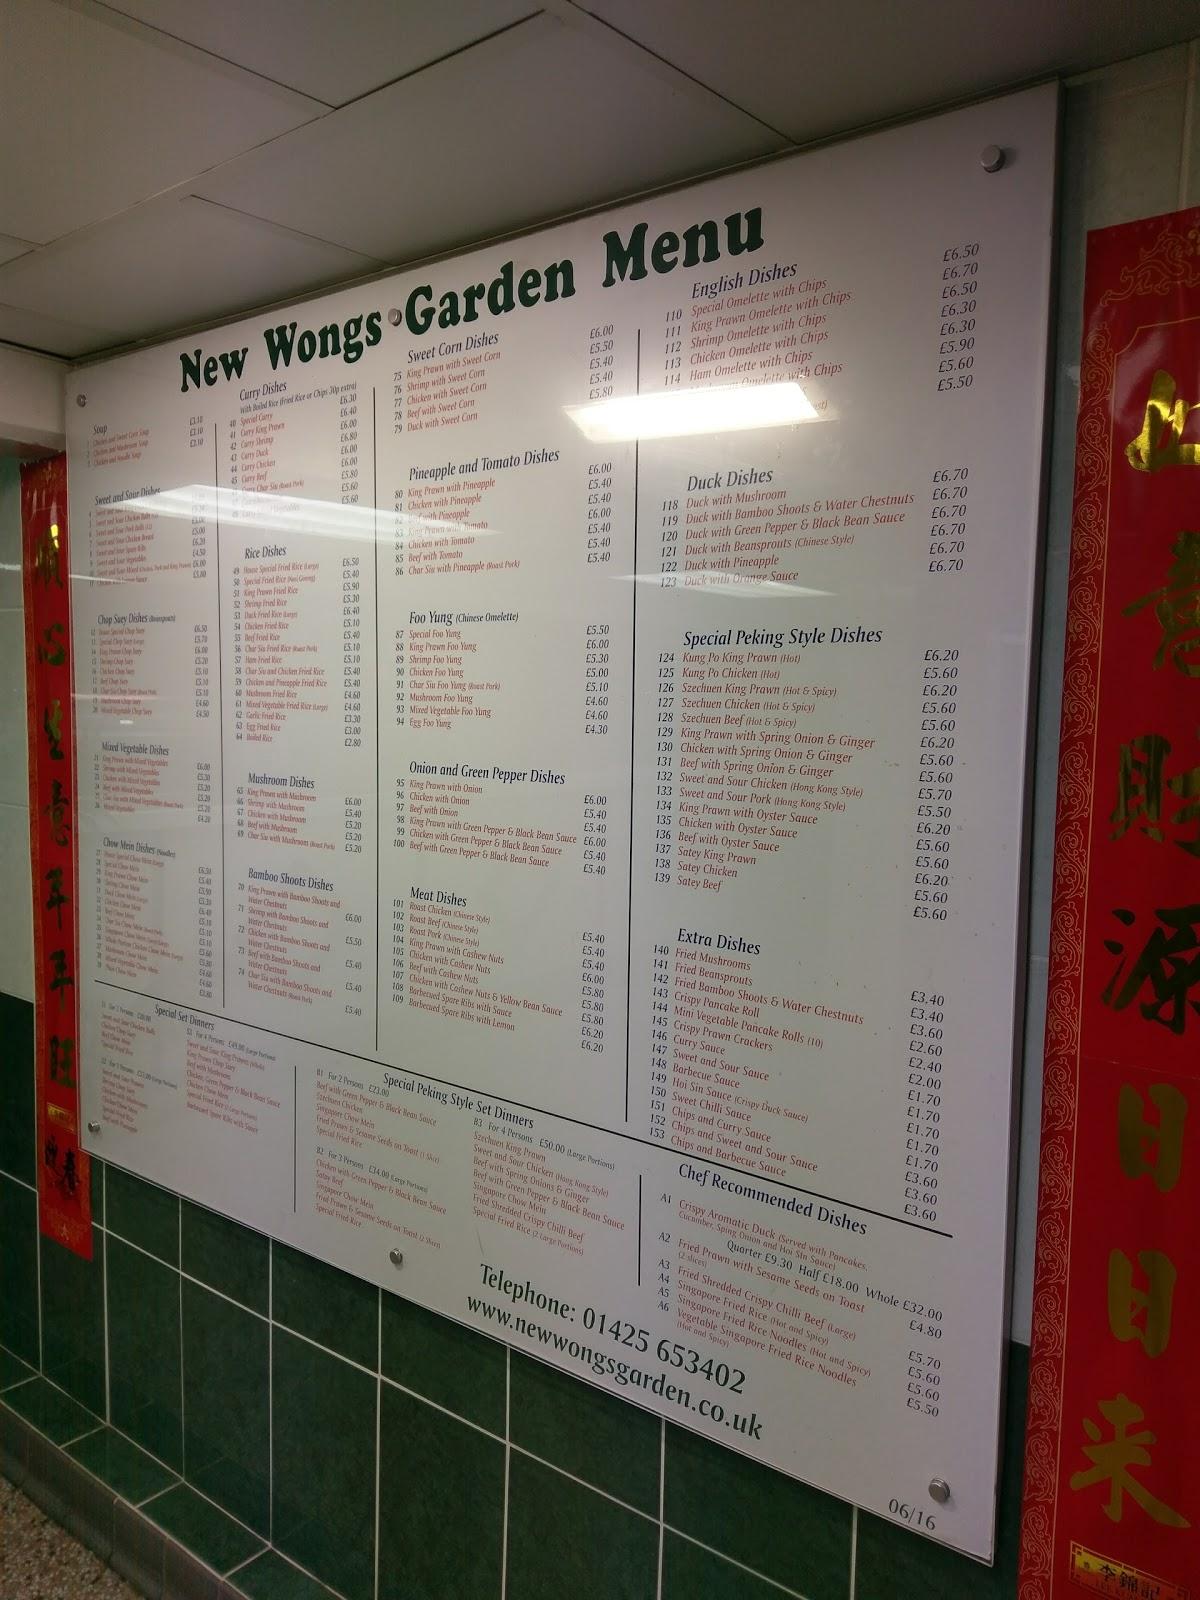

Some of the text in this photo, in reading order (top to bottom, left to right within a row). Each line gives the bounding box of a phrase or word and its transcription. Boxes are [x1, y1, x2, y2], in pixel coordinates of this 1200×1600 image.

[943, 243, 980, 262] £6.50
[692, 263, 797, 299] English Dishes
[180, 207, 766, 392] New Wongs Garden Menu
[666, 279, 827, 322] 110 Special Omelette with Chips
[590, 324, 614, 339] £6.00
[407, 333, 499, 364] Sweet Corn Dishes
[393, 351, 501, 382] 75 King Prawn with Sweet Corn
[239, 381, 287, 401] Curry Dishes
[340, 418, 358, 430] £6.00
[409, 448, 560, 481] Pineapple and Tomato Dishes
[933, 467, 969, 483] £6.70
[687, 468, 773, 492] Duck Dishes
[662, 493, 915, 527] 119 Duck with Bamboo Shoots & Water Chestnuts
[245, 544, 287, 559] Rice Dishes
[588, 537, 611, 549] £5.40
[409, 610, 519, 627] Foo Yung (Chinese Omelette)
[683, 626, 883, 650] Special Peking Style Dishes
[659, 652, 800, 666] 124 Kung Po King Prawn (Hot)
[924, 650, 959, 662] £6.20
[396, 692, 473, 705] 92 Mushroom Foo Yung
[585, 696, 609, 707] £4.60
[658, 727, 875, 751] 129 King Prawn with Spring Onion & Ginger
[248, 773, 315, 789] Mushroom Dishes
[410, 761, 565, 785] Onion and Green Pepper Dishes
[345, 797, 362, 807] £6.00
[397, 815, 577, 844] 98 King Prawn with Green Pepper & Black Bean Sauce
[583, 836, 607, 848] £6.00
[248, 868, 334, 892] Bamboo Shoots Dishes
[410, 886, 467, 907] Meat Dishes
[678, 928, 761, 955] Extra Dishes
[654, 944, 751, 971] 140 Fried Mushrooms
[581, 986, 604, 999] £5.80
[653, 987, 760, 1018] 143 Crispy Pancake Roll
[911, 990, 945, 1007] £3.40
[383, 1073, 534, 1129] Special Peking Style Set Dinners
[473, 1117, 615, 1171] B3 For 4 Persons £50.00 (Large Portions)
[679, 1163, 867, 1235] Chef Recommended Dishes
[727, 1239, 943, 1322] Quarter £9.30 Half £18.00 Whole £32.00
[480, 1263, 746, 1394] Telephone: 01425 653402
[468, 1296, 762, 1440] www.newwongsgarden.co.uk
[889, 1499, 936, 1530] 06/16
